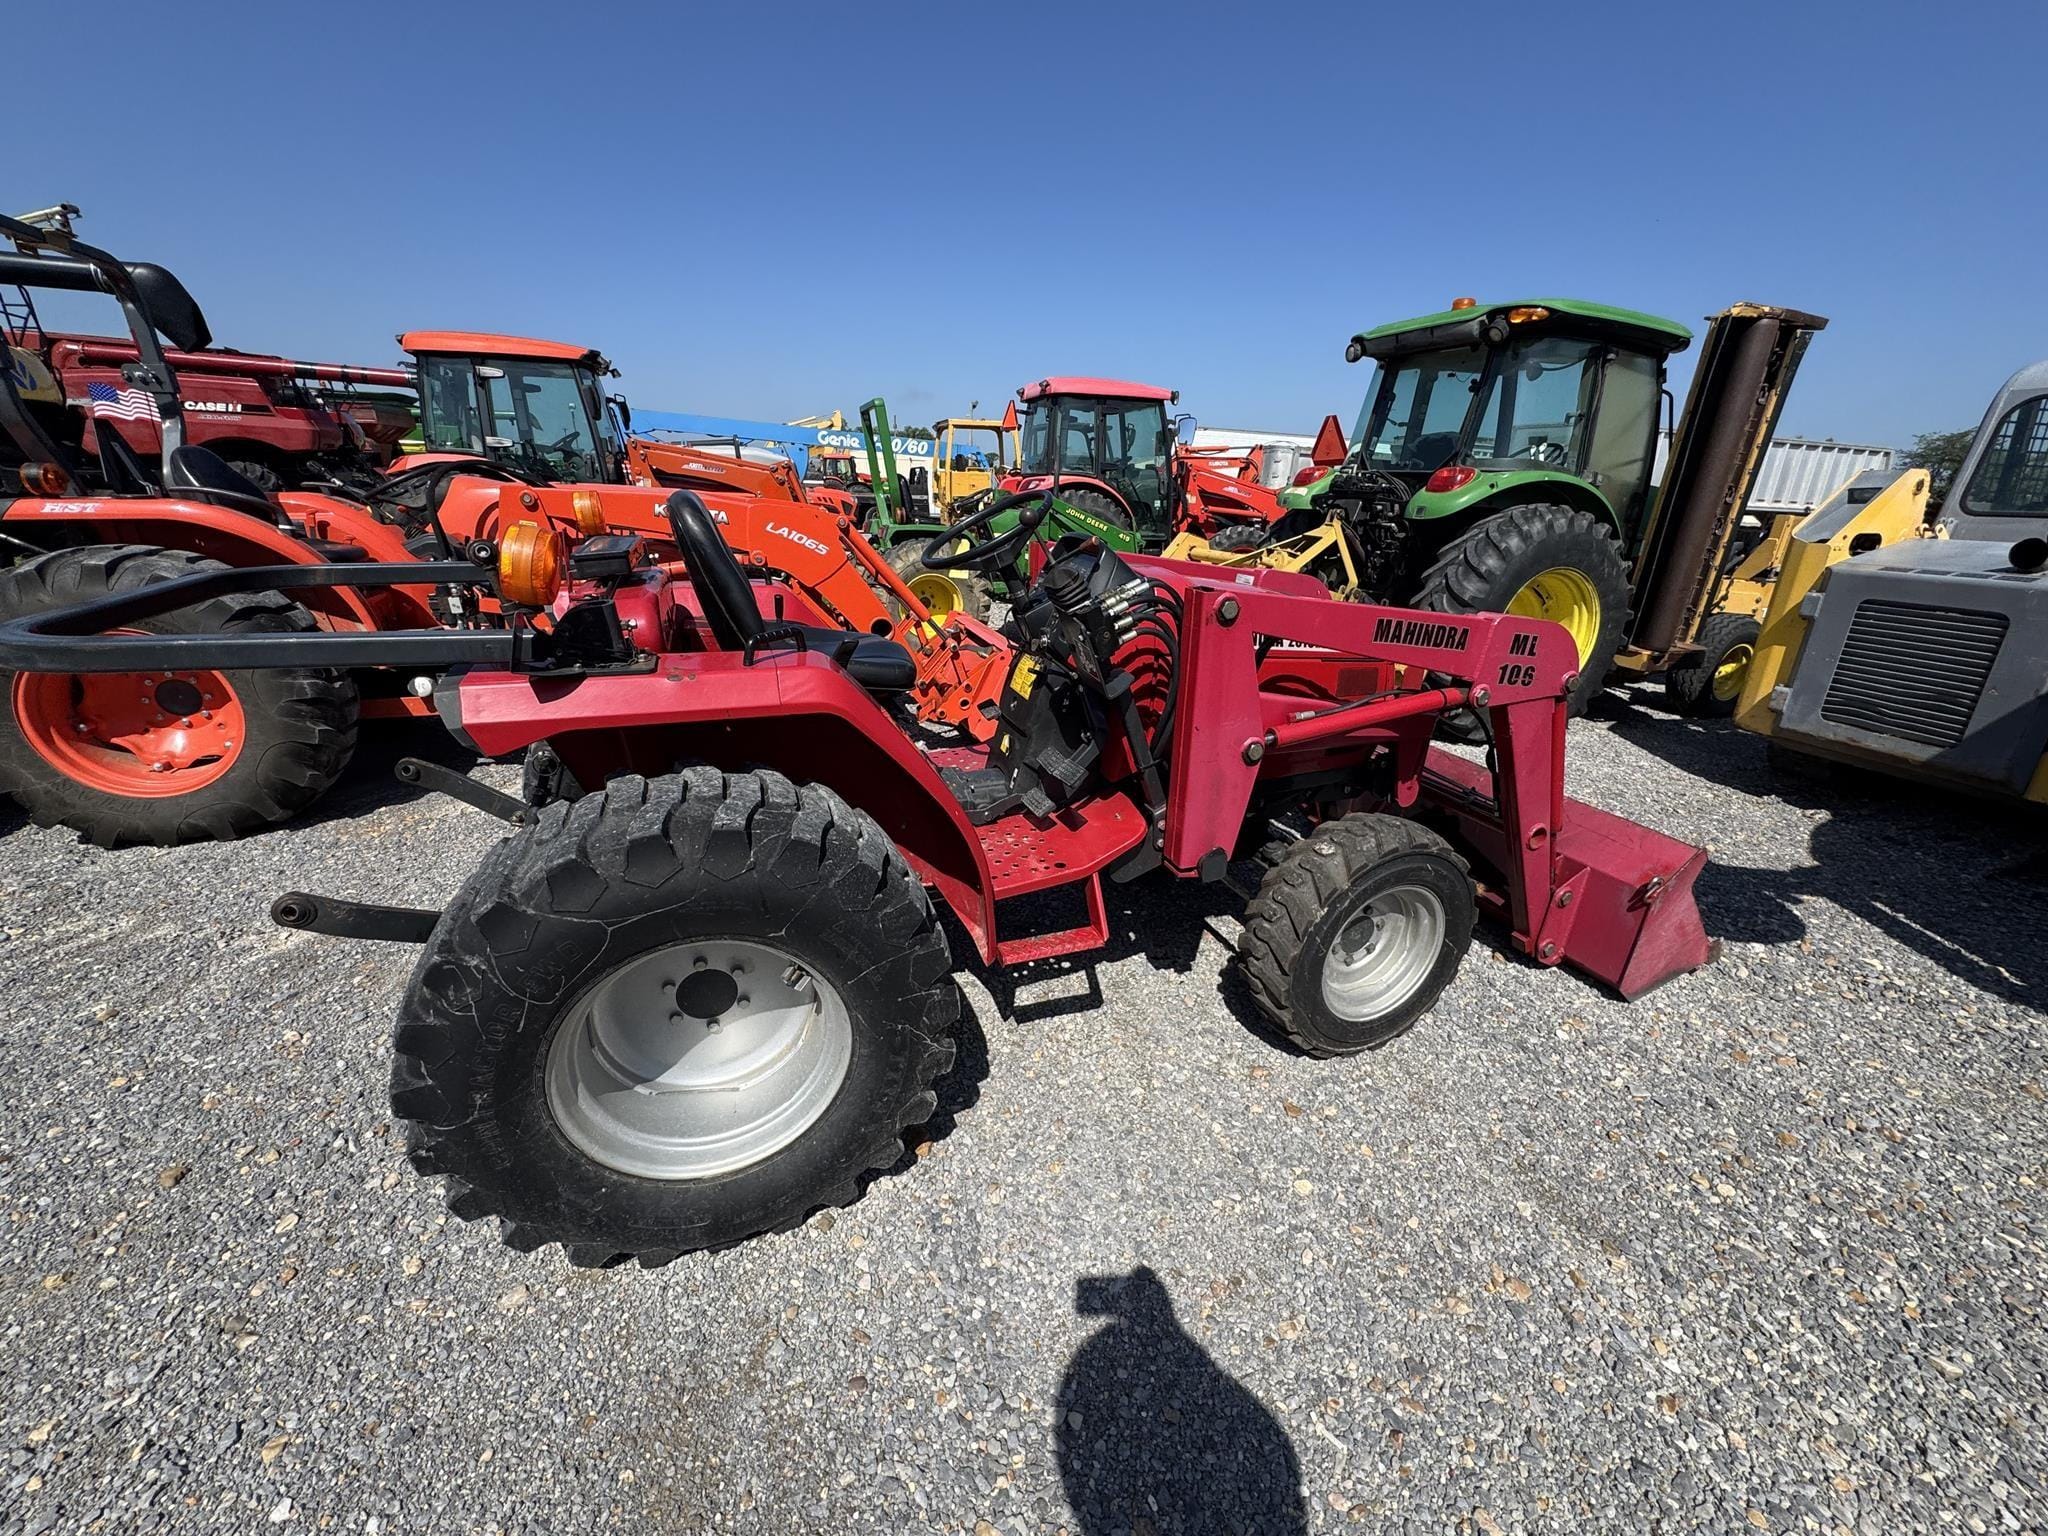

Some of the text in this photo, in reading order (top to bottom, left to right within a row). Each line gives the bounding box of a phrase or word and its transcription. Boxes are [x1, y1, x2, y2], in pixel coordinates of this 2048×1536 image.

[184, 401, 227, 411] CASE
[817, 431, 860, 448] Genie
[40, 502, 101, 513] HST
[654, 503, 730, 525] KTA
[1065, 507, 1109, 532] JOHN DEERE
[765, 522, 830, 555] LA1065
[1372, 617, 1470, 651] MAHINDRA
[1509, 632, 1539, 657] ML
[1497, 663, 1536, 687] 106
